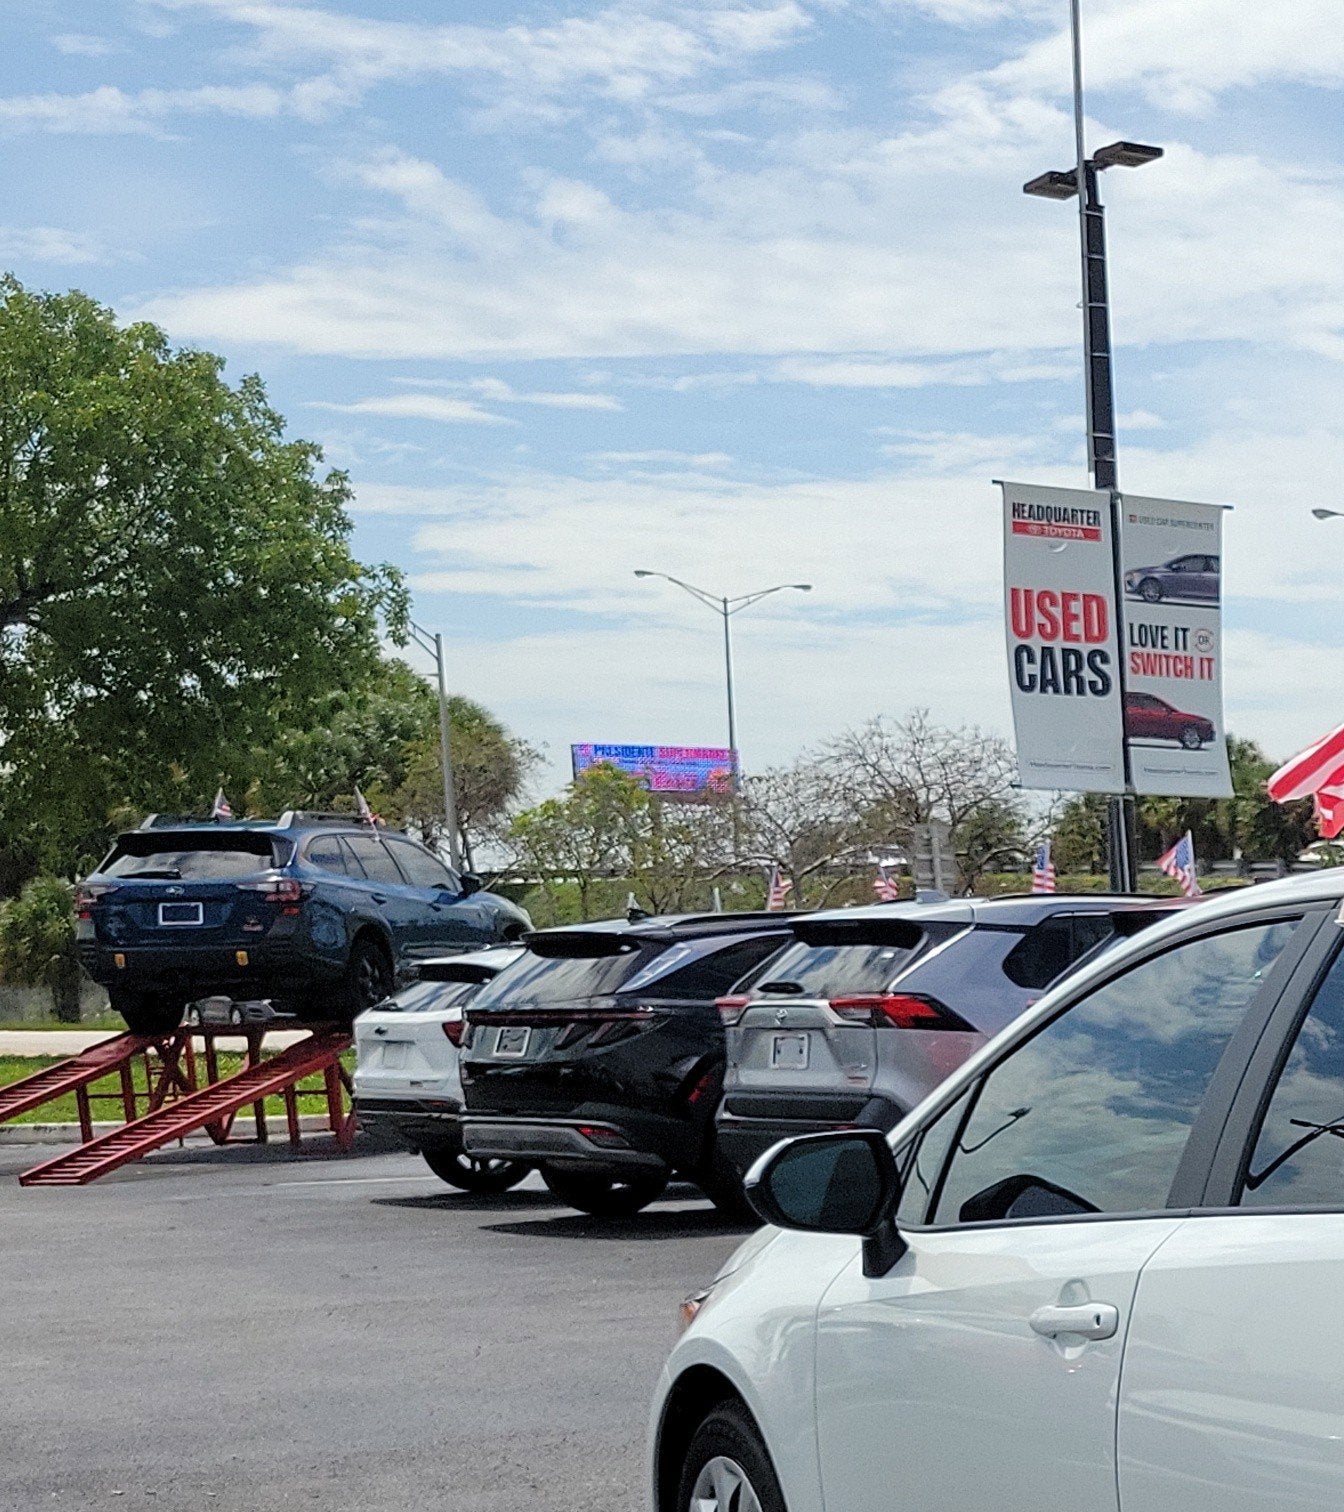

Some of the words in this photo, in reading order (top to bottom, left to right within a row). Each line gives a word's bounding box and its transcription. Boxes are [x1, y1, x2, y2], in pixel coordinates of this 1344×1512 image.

[1012, 502, 1101, 527] HEADQUARTER
[1042, 526, 1085, 538] TOYOTA
[1011, 587, 1109, 644] USED
[1129, 622, 1168, 650] LOVE
[1174, 626, 1190, 652] IT
[1014, 644, 1112, 697] CARS
[1131, 651, 1194, 679] SWITCH
[1199, 656, 1215, 681] IT
